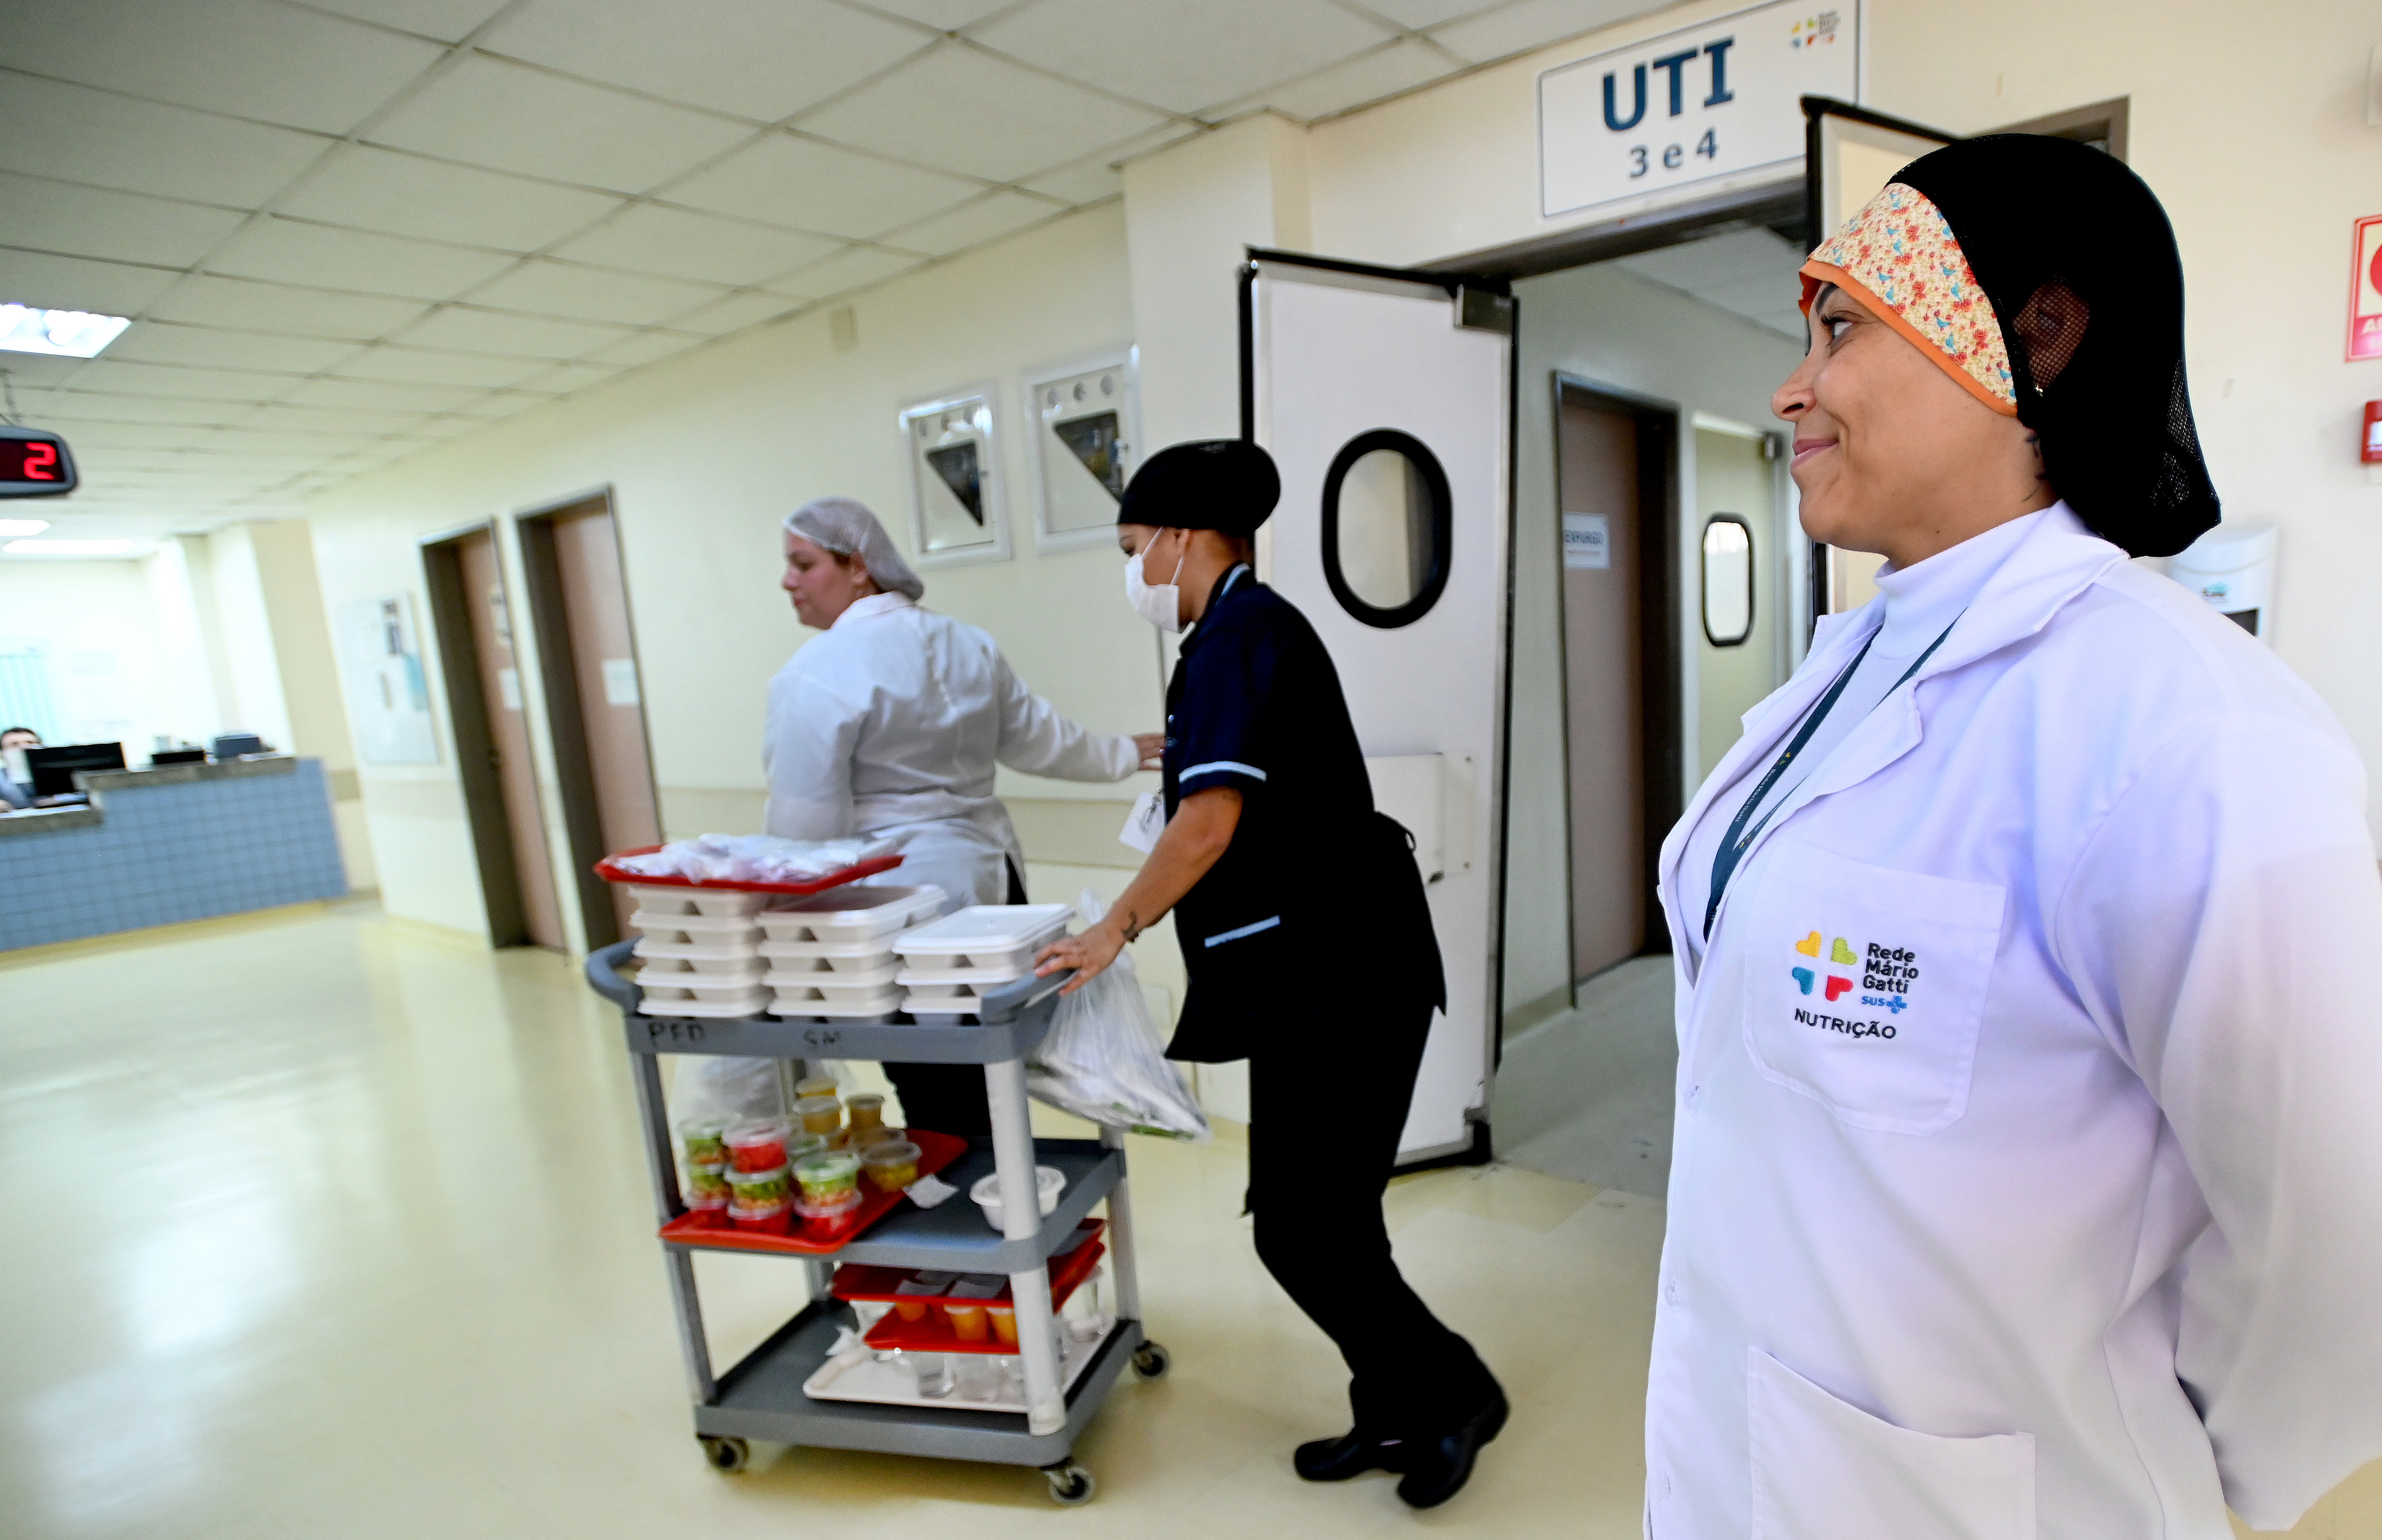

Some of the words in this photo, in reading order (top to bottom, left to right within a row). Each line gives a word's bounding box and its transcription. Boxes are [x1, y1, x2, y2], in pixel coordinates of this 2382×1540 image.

[1603, 36, 1734, 132] UTI
[1629, 145, 1648, 177] 3
[1664, 143, 1682, 168] e
[1696, 127, 1718, 158] 4
[24, 442, 56, 480] 2
[1868, 942, 1915, 962] Rede
[1863, 975, 1909, 994] Gatti
[1865, 959, 1919, 979] Mário
[1795, 1008, 1897, 1039] NUTRIÇÃO
